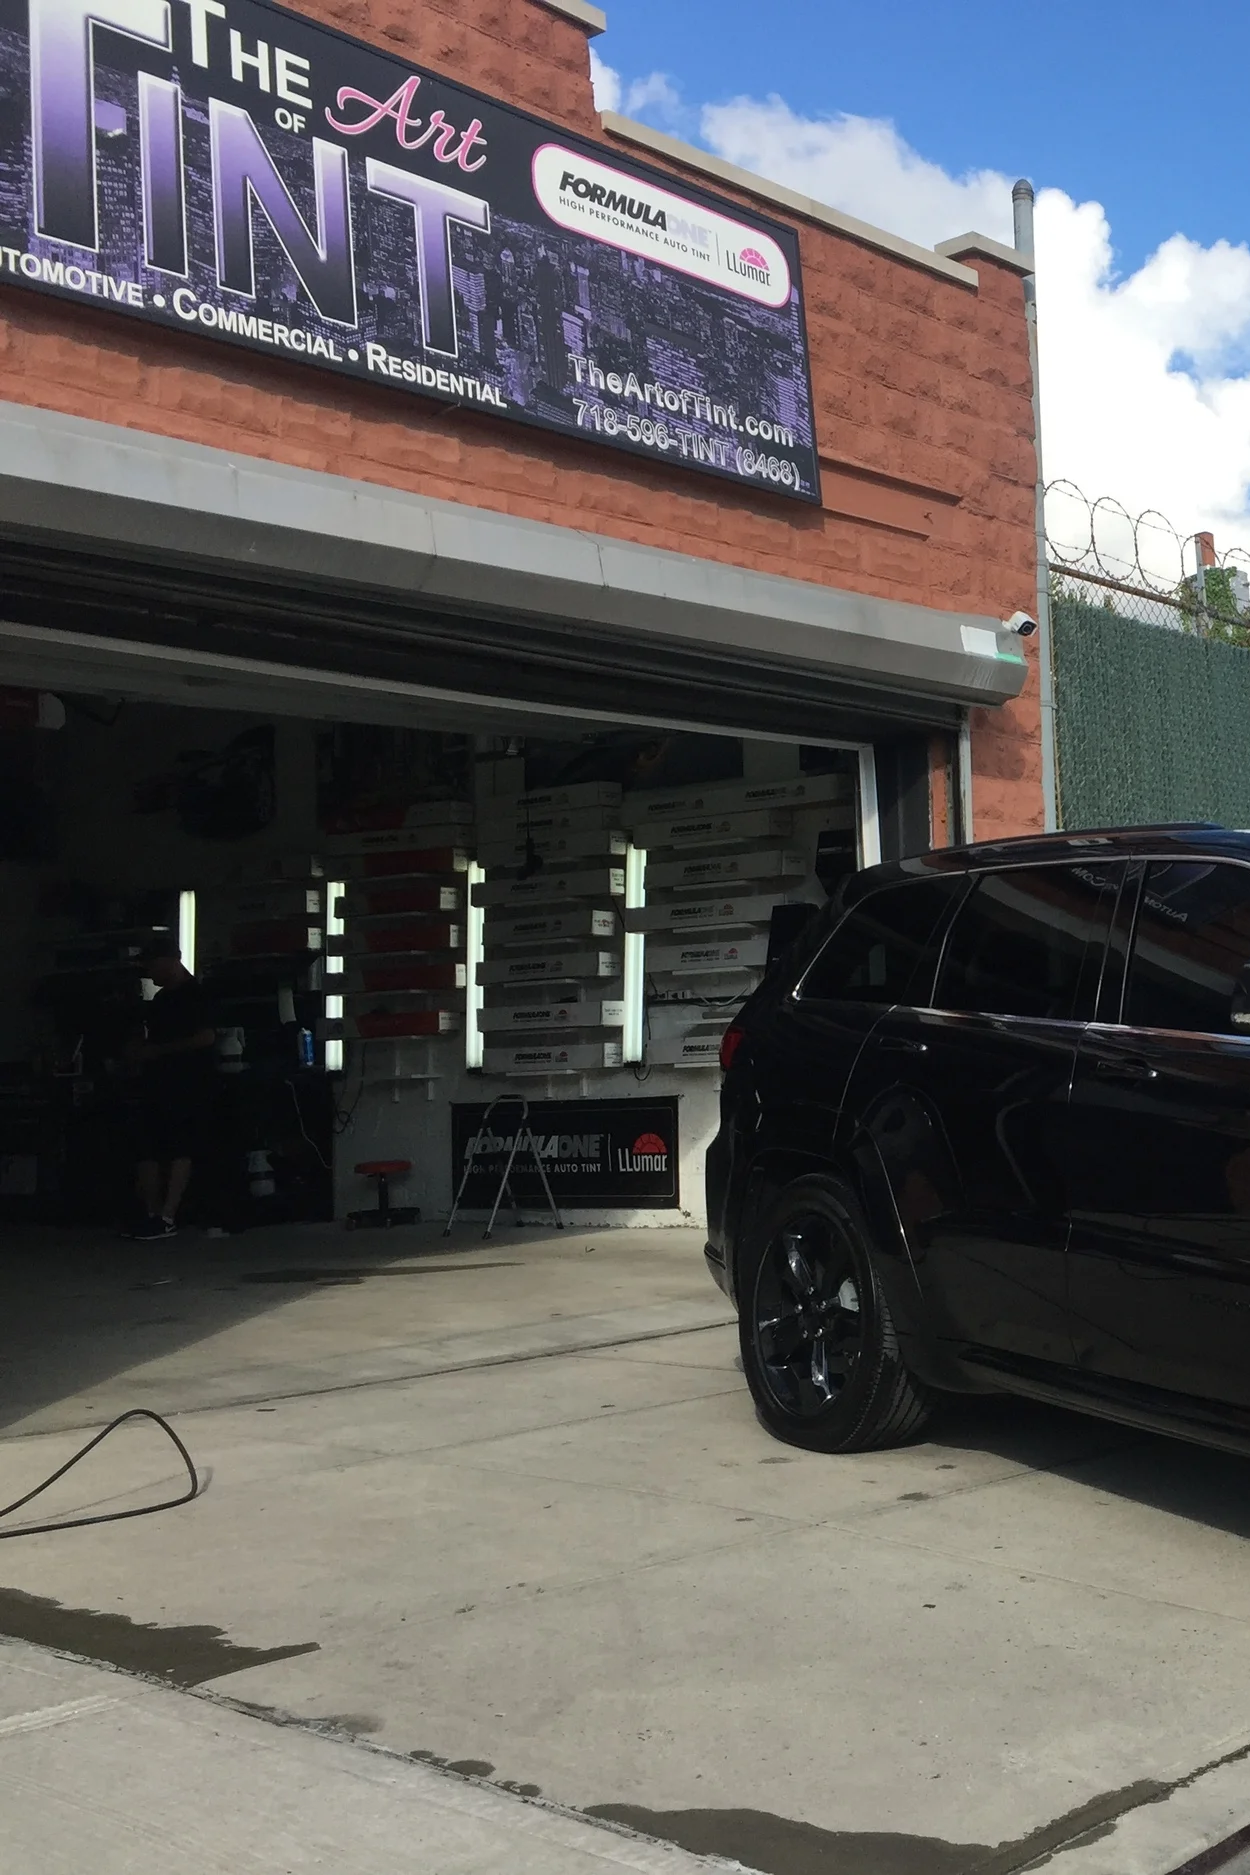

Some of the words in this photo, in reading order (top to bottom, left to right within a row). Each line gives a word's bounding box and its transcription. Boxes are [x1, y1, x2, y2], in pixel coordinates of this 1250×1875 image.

[179, 0, 313, 109] THE
[274, 107, 306, 133] OF
[325, 75, 488, 172] Art
[29, 0, 491, 358] TINT
[558, 196, 585, 213] HIGH
[589, 207, 660, 242] PERFORMANCE
[663, 238, 688, 253] AUTO
[691, 249, 711, 262] TINT
[725, 249, 771, 286] LLumar
[0, 246, 145, 308] TOMOTIVE
[173, 287, 343, 361] COMMERCIAL
[366, 341, 508, 408] RESIDENTIAL
[568, 353, 794, 447] TheArtofTint.com
[572, 398, 729, 466] 718-596-TINT
[735, 445, 801, 491] (8468)
[553, 1163, 579, 1173] AUTO
[581, 1163, 602, 1173] TINT
[617, 1147, 668, 1172] LLumar
